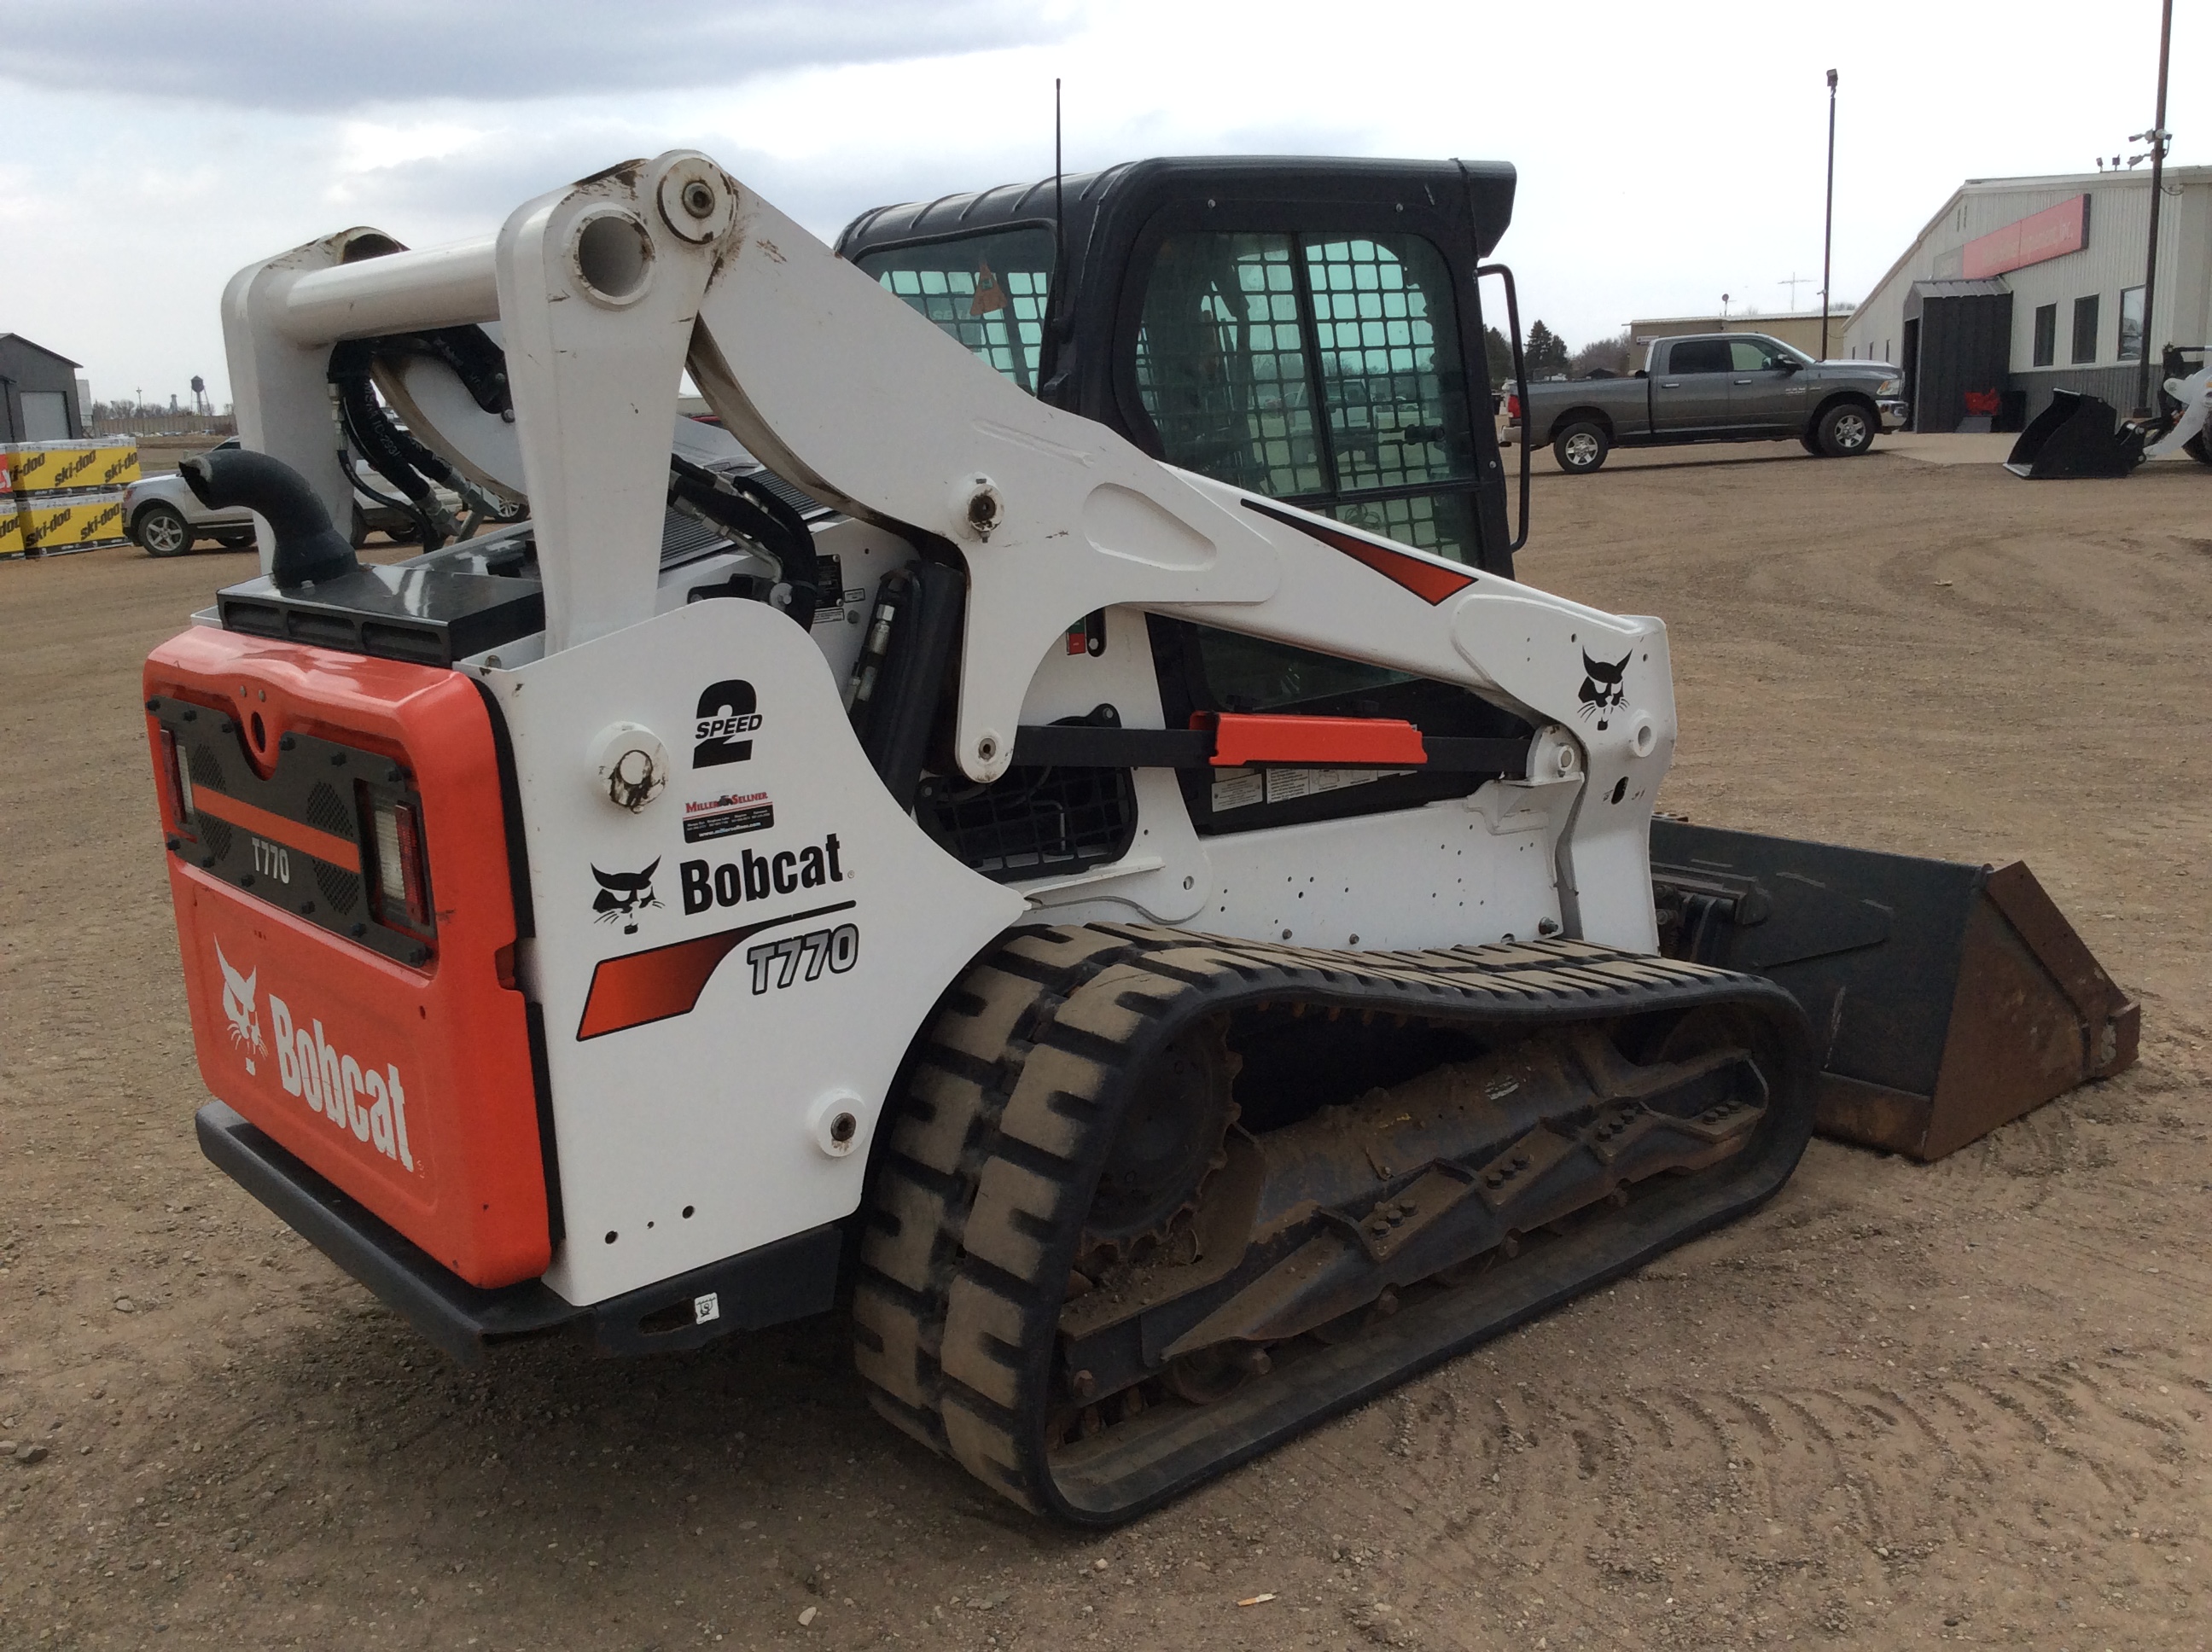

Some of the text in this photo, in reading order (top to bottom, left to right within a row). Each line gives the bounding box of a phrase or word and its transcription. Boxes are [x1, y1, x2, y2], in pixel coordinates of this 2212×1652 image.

[55, 450, 96, 487] ski-doo
[26, 508, 71, 547] ski-doo
[80, 503, 120, 541] ski-doo
[692, 679, 758, 770] 2
[695, 713, 763, 740] SPEED
[252, 837, 290, 884] T770
[679, 833, 843, 916] Bobcat
[747, 922, 859, 996] T770
[268, 993, 415, 1173] Bobcat
